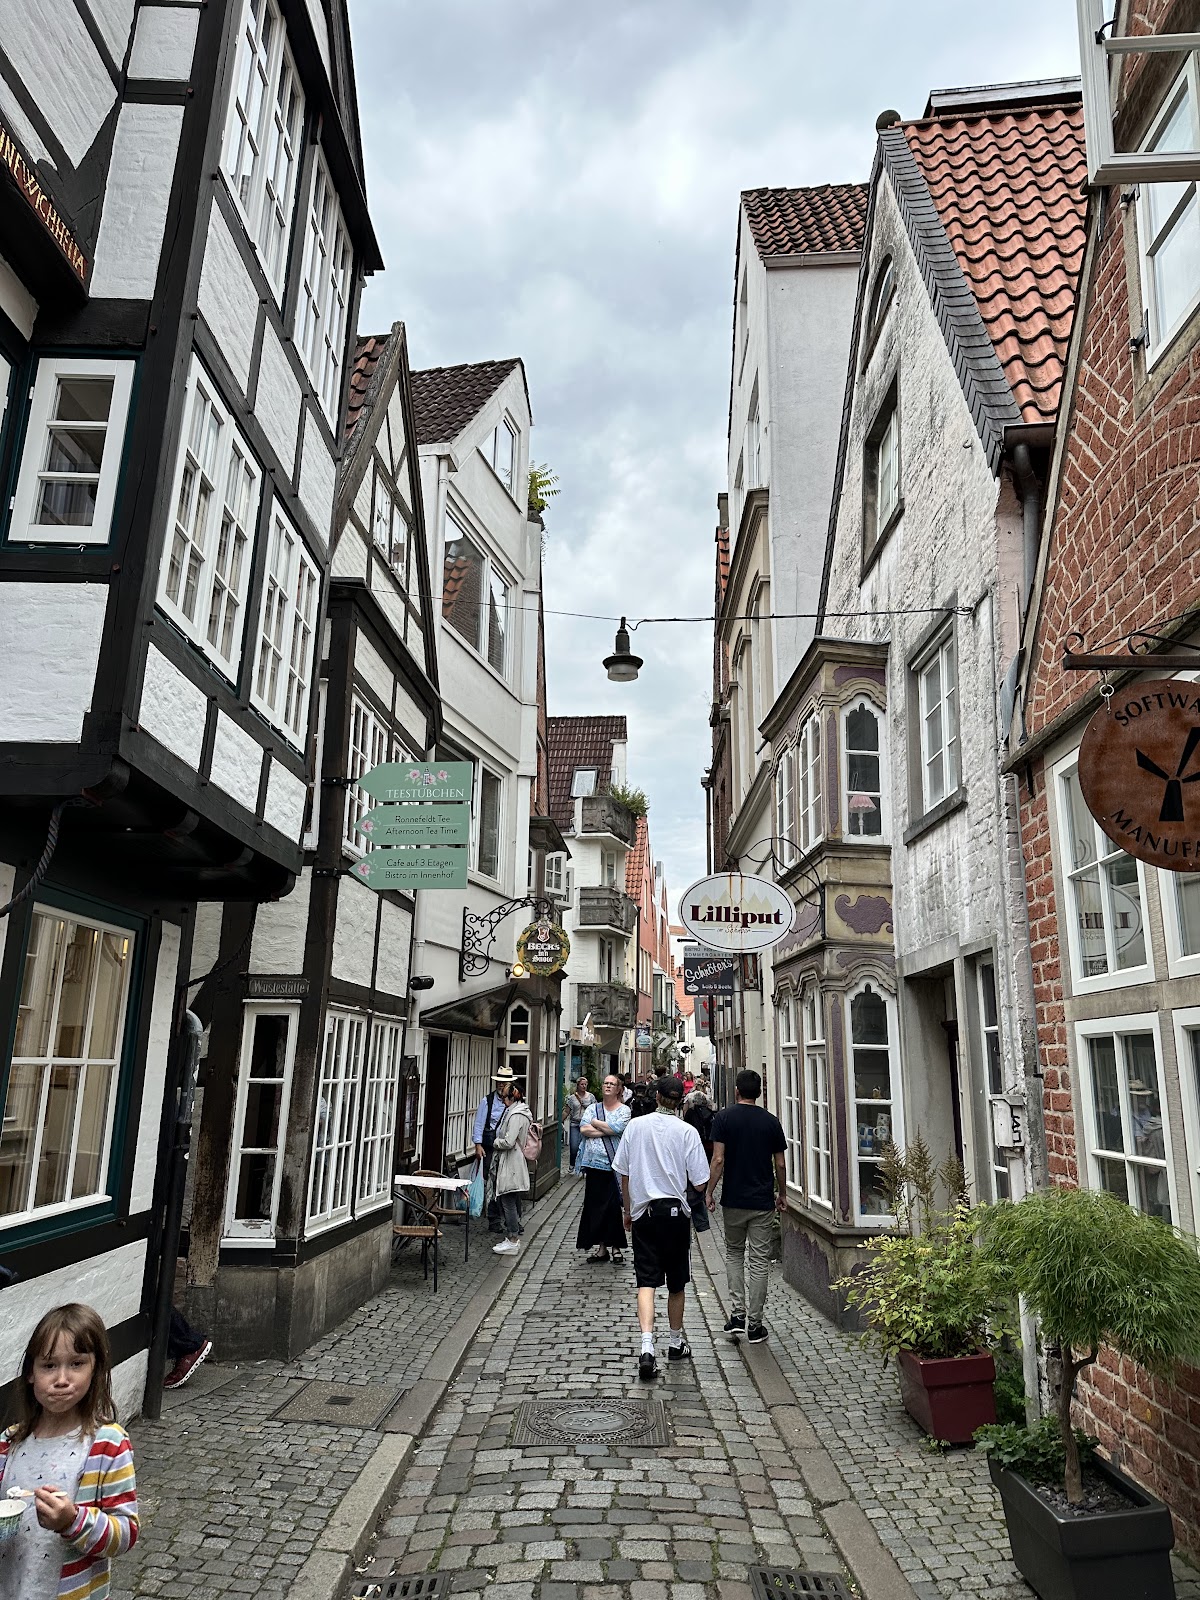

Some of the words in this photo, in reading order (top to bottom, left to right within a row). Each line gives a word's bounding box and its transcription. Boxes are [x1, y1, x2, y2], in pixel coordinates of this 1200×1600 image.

[386, 787, 465, 798] TEESTÜBCHEN
[395, 815, 436, 823] Ronnefeldt
[438, 814, 451, 823] Tee
[385, 827, 424, 835] Afternoon
[426, 827, 438, 835] Tea
[440, 826, 458, 834] Time
[386, 858, 404, 867] Cafe
[406, 858, 419, 867] auf
[421, 859, 426, 867] 3
[427, 859, 454, 869] Etagen
[385, 871, 407, 879] Bistro
[408, 871, 418, 879] im
[420, 870, 454, 879] Innenhof
[690, 904, 784, 929] Lilliput
[685, 959, 733, 983] Schröter's
[254, 980, 305, 994] Wüstestätte
